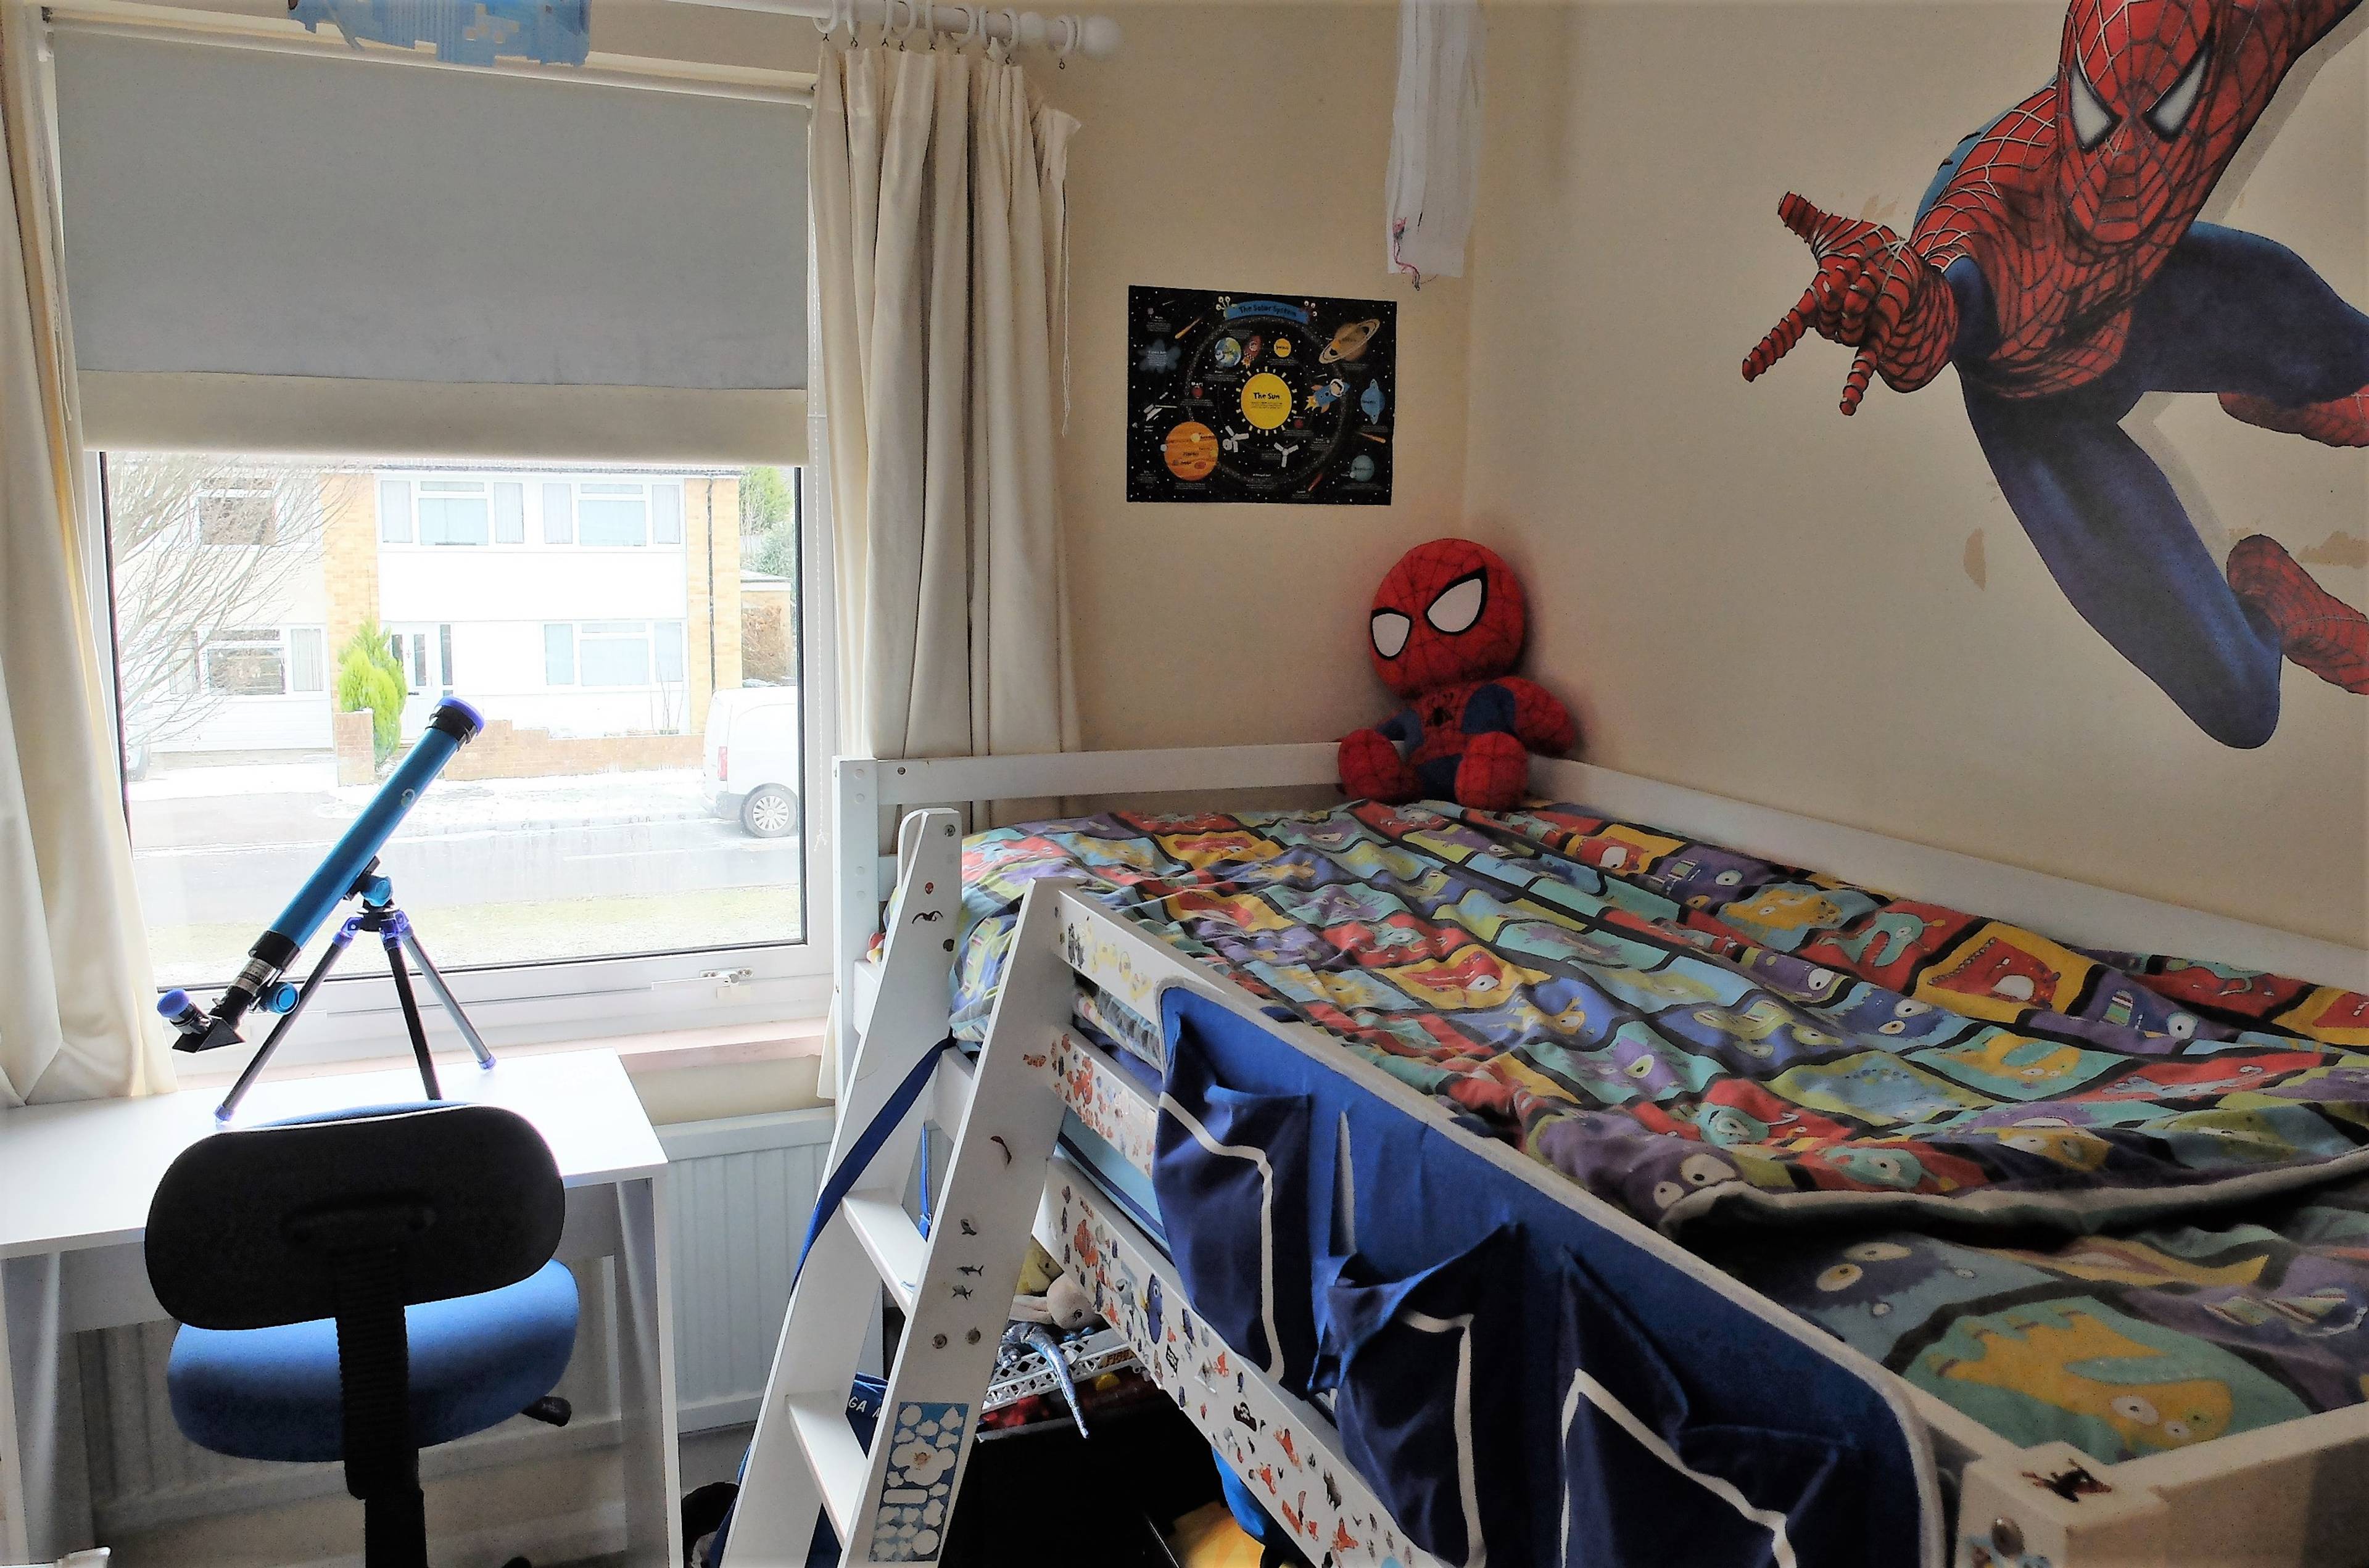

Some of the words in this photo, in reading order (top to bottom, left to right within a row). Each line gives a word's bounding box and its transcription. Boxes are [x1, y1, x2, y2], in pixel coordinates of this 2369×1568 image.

[1239, 305, 1252, 313] The
[1273, 306, 1297, 316] System
[1253, 392, 1266, 400] The
